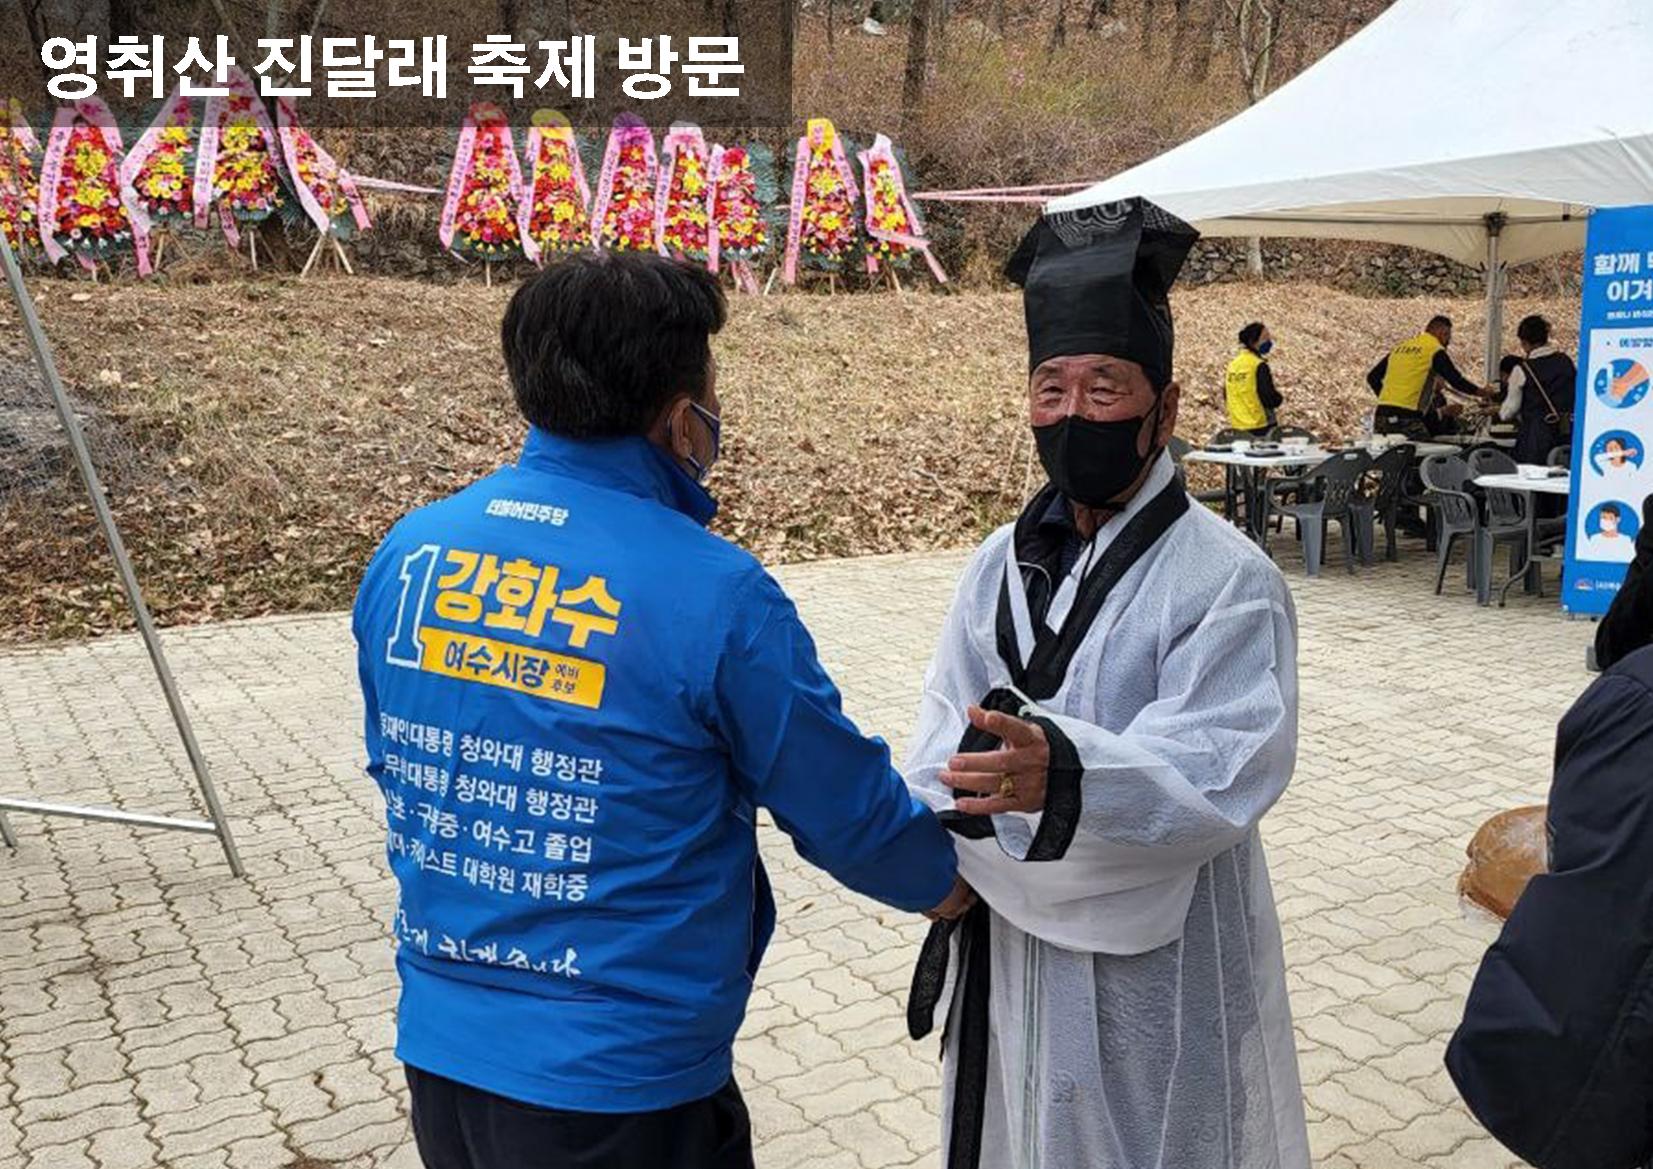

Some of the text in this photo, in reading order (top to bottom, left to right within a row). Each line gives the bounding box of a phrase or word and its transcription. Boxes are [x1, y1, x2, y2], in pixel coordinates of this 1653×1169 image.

[1594, 252, 1640, 276] 함께
[434, 549, 622, 648] 강화수
[444, 640, 551, 688] 여수시장
[459, 734, 524, 772] 청와대
[531, 748, 603, 785] 행정관
[455, 774, 518, 812] 청와대
[525, 787, 599, 824] 행정관
[543, 832, 592, 863] 졸업
[463, 857, 515, 893] 대학원
[521, 871, 588, 901] 재학중
